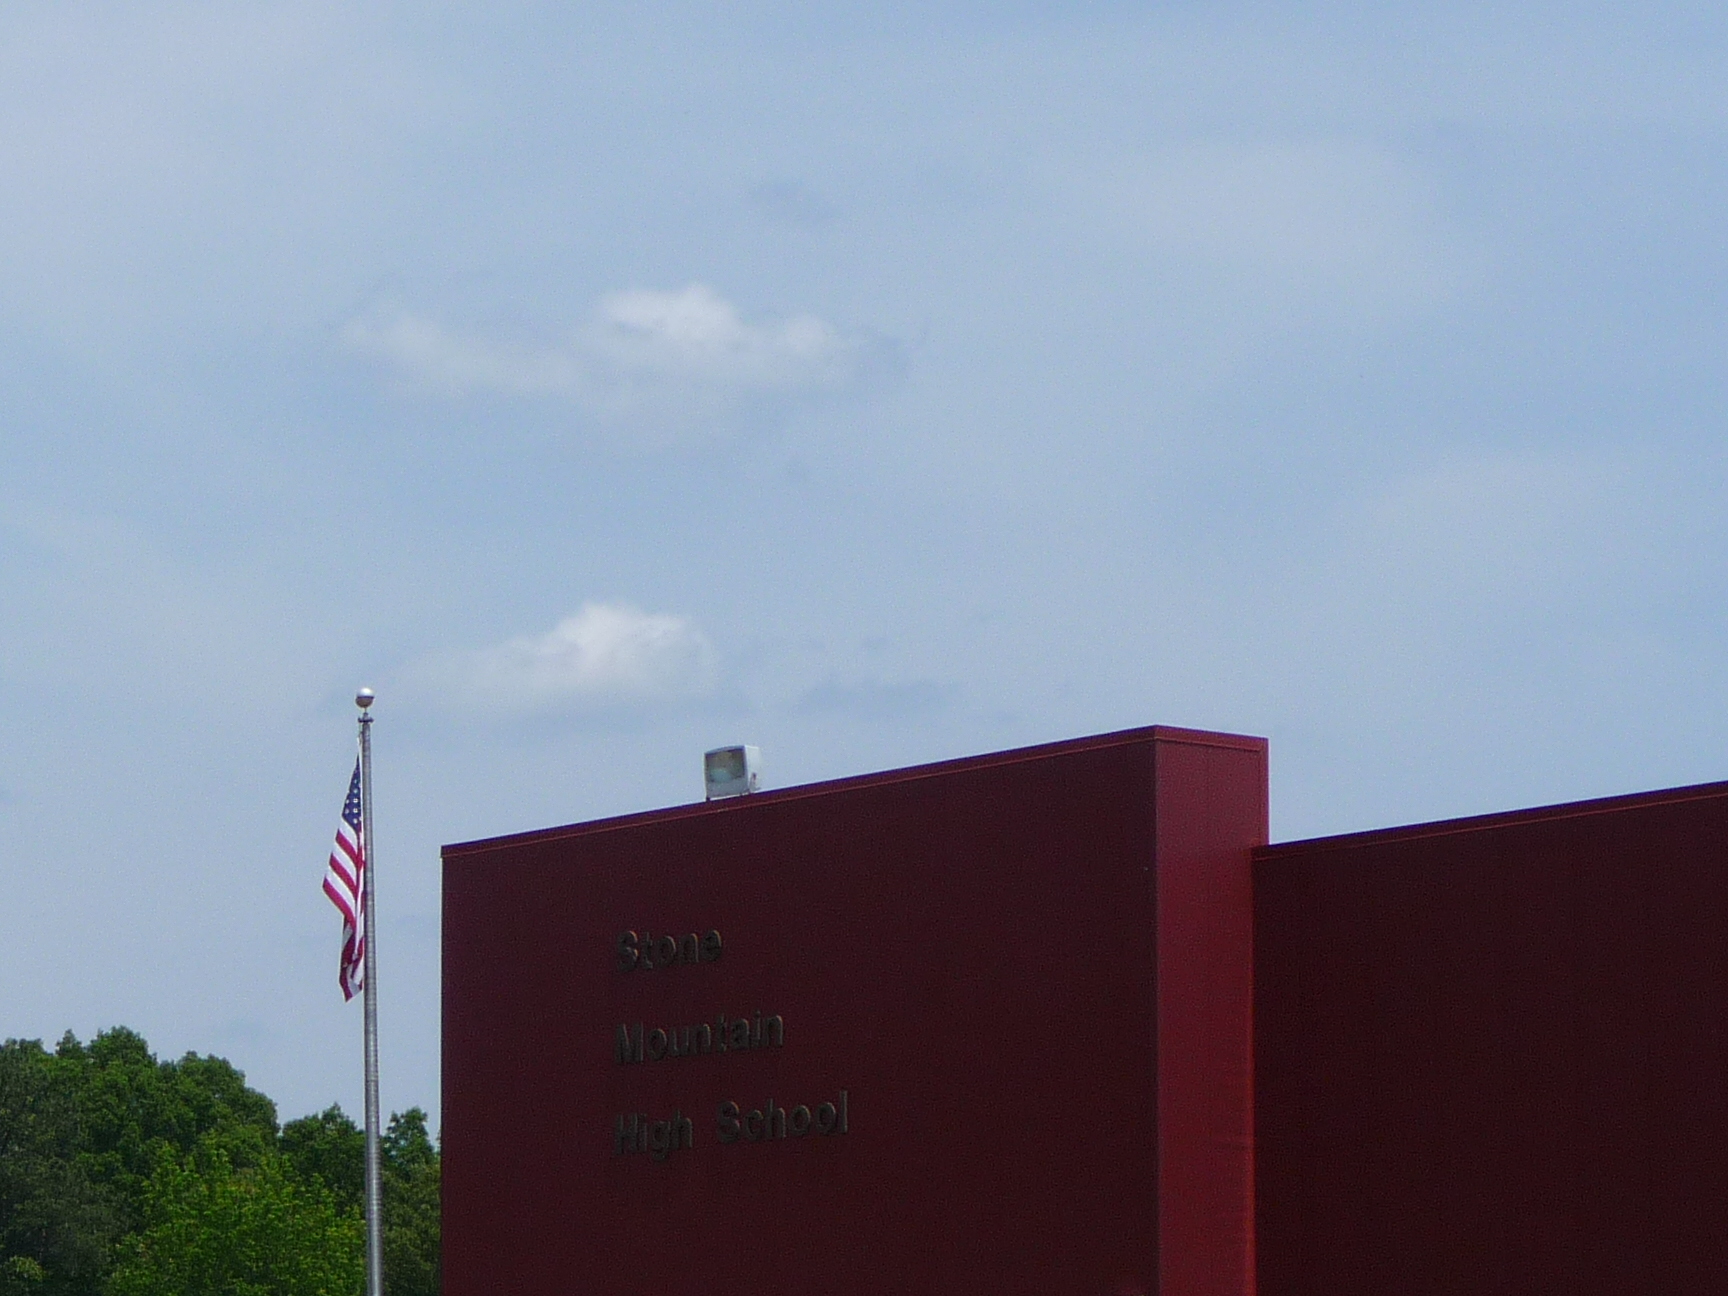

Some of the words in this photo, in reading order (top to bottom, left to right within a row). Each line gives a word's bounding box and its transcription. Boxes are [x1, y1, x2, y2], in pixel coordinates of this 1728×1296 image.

[616, 930, 721, 972] Stone
[615, 1010, 783, 1063] Mountain
[614, 1110, 693, 1160] High
[719, 1089, 848, 1143] School
